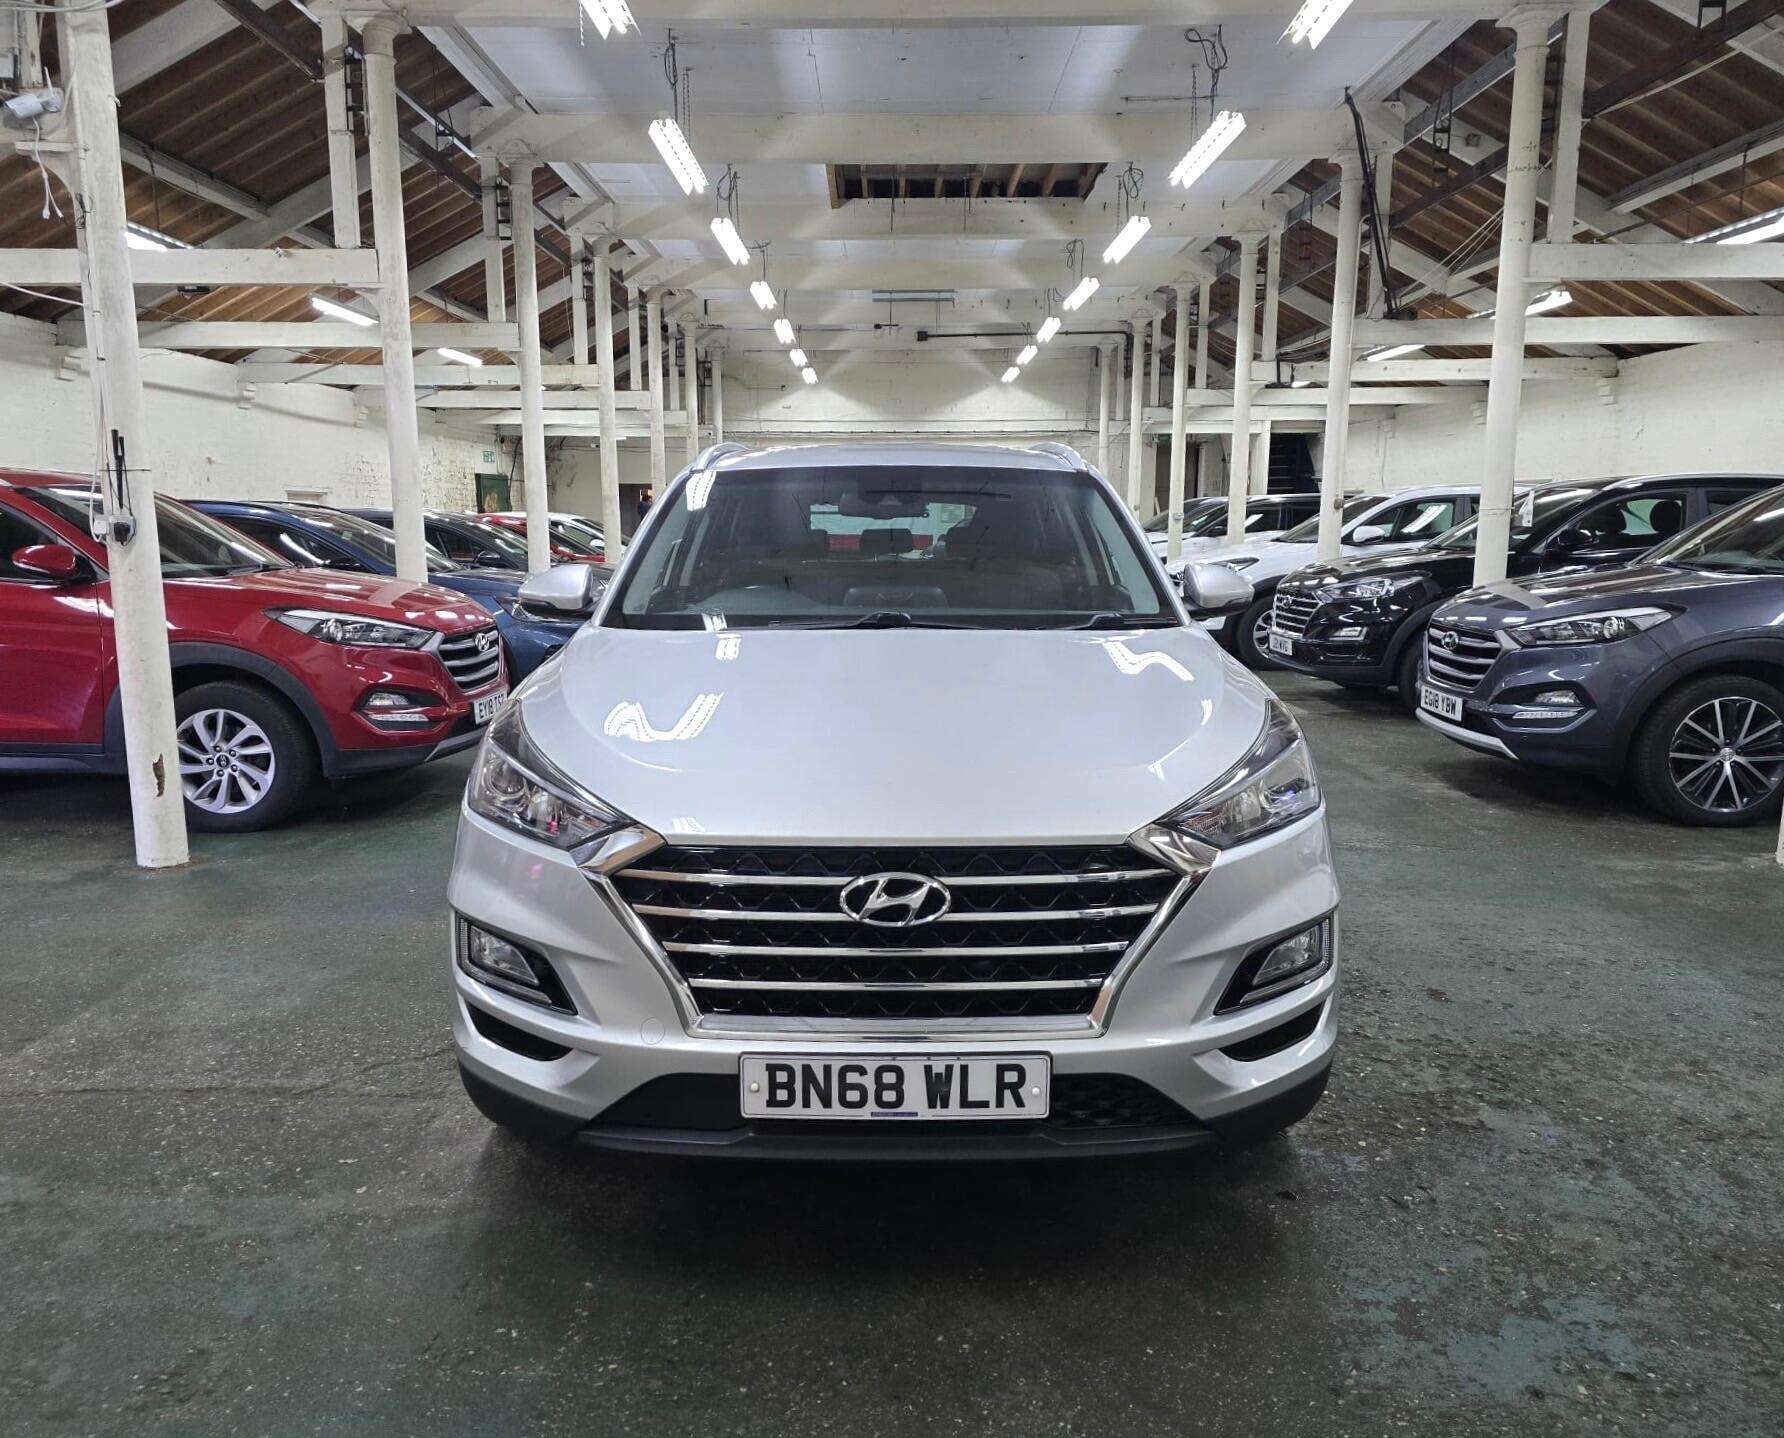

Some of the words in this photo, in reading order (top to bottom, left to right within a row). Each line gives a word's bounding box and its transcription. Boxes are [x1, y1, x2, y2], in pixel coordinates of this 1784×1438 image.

[1424, 689, 1439, 709] EG18
[1441, 695, 1457, 715] YBW
[765, 1063, 905, 1109] BN68
[923, 1063, 1027, 1109] WLR
